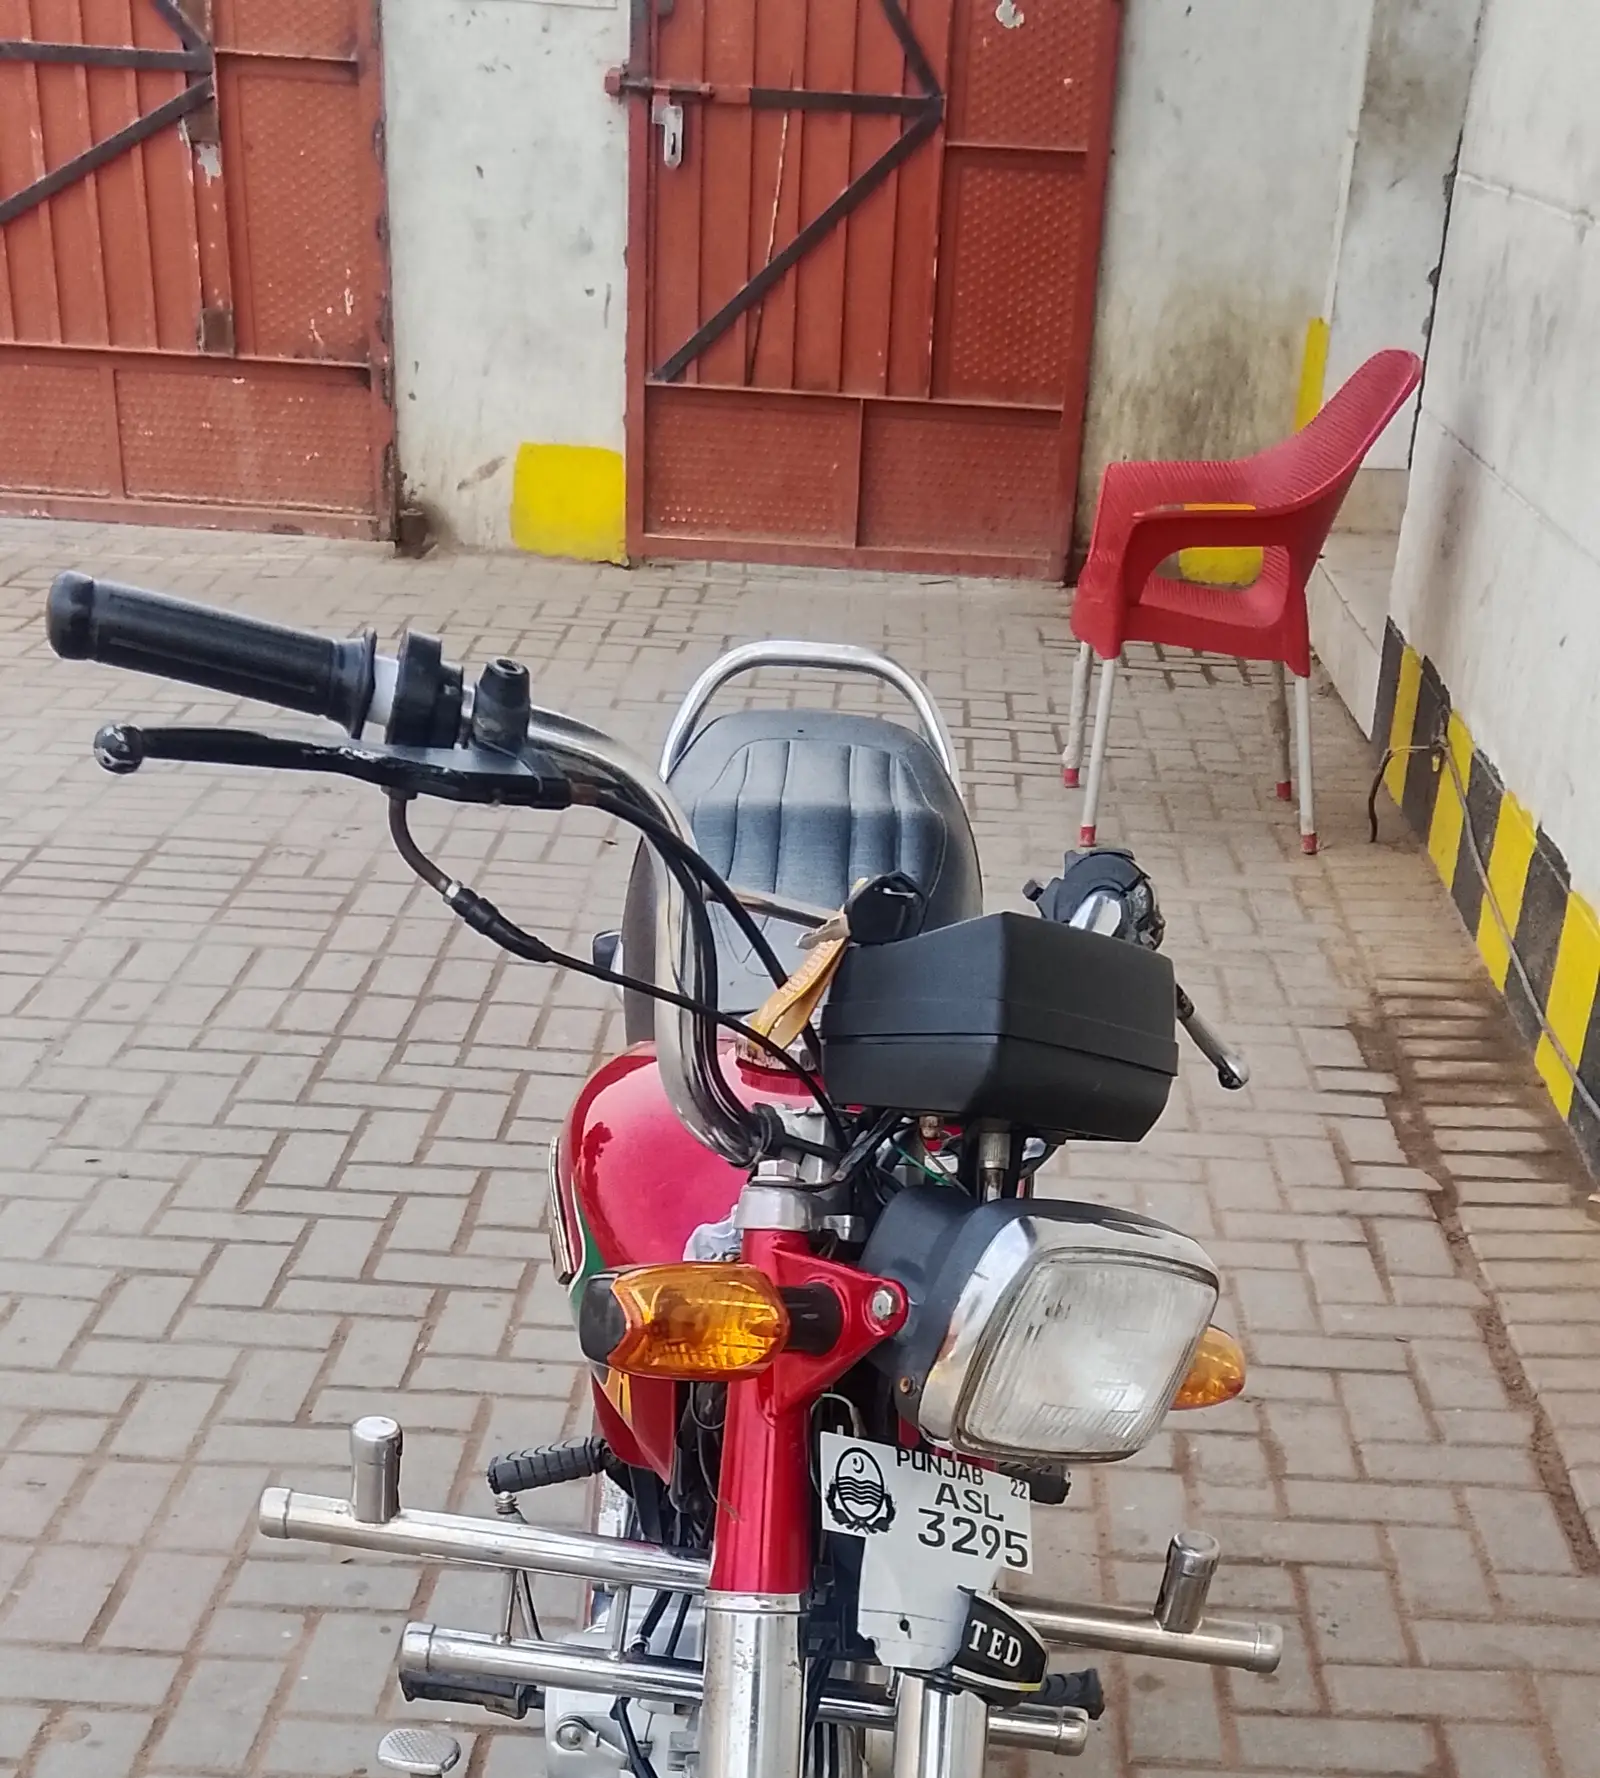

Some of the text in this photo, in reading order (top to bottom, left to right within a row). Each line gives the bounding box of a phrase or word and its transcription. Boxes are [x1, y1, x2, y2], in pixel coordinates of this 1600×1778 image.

[896, 1450, 984, 1485] PUNJAB
[935, 1483, 1004, 1522] ASL
[1010, 1478, 1027, 1499] 22
[917, 1508, 1028, 1568] 3295
[968, 1619, 1022, 1668] TED
